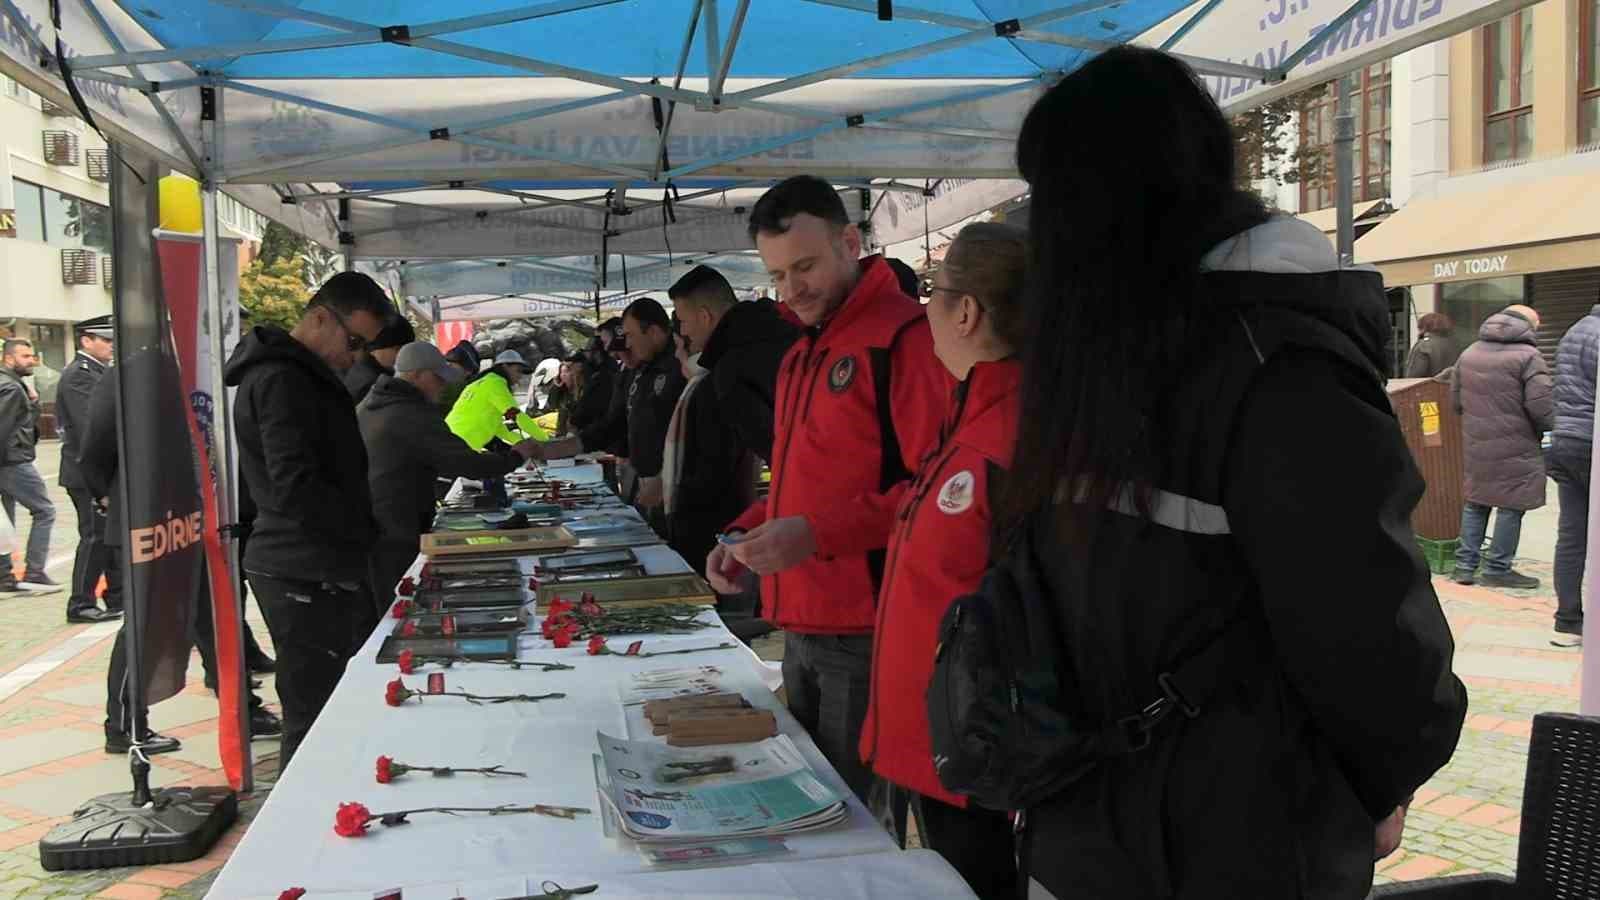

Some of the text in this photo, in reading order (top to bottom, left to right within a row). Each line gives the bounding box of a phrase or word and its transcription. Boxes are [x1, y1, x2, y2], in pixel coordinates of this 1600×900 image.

[1434, 255, 1508, 278] DAY TODAY
[130, 510, 202, 564] EDİRNE
